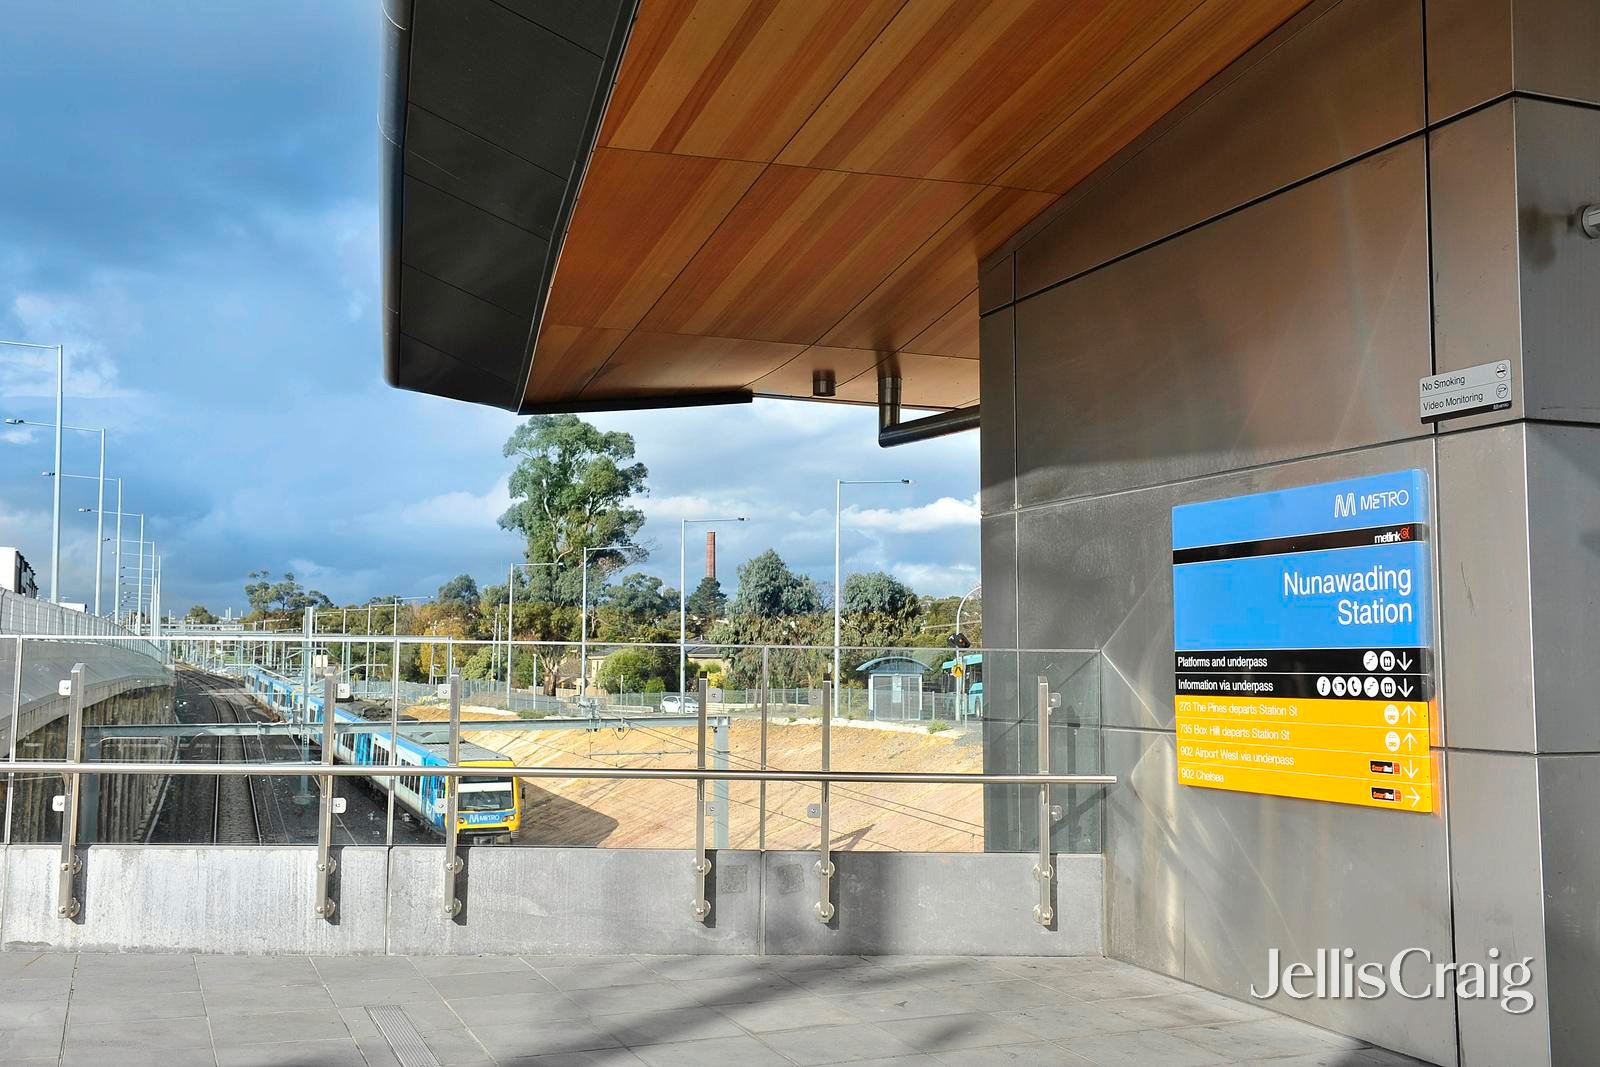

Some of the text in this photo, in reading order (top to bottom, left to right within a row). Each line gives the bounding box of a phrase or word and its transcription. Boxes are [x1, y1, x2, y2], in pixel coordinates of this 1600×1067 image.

[1422, 376, 1466, 391] No Smoking
[1423, 401, 1444, 411] Video
[1445, 393, 1484, 406] Monitoring
[1360, 489, 1410, 511] METRO
[1374, 531, 1401, 543] metlink
[1284, 565, 1412, 597] Nunawading
[1337, 599, 1413, 625] Station
[1177, 656, 1268, 669] Platforms and underpass
[1178, 679, 1274, 693] Information via underpass
[1192, 702, 1206, 712] The
[1207, 703, 1227, 714] Pines
[1228, 704, 1258, 716] departs
[1259, 704, 1287, 716] Station
[1288, 705, 1298, 717] St
[1193, 724, 1208, 736] Box
[1209, 726, 1221, 736] Hill
[1222, 727, 1250, 739] departs
[1251, 728, 1279, 740] Station
[1280, 729, 1290, 741] St
[1180, 745, 1295, 767] 902 Airport West via underpass
[1181, 767, 1225, 783] 902 Chelsea
